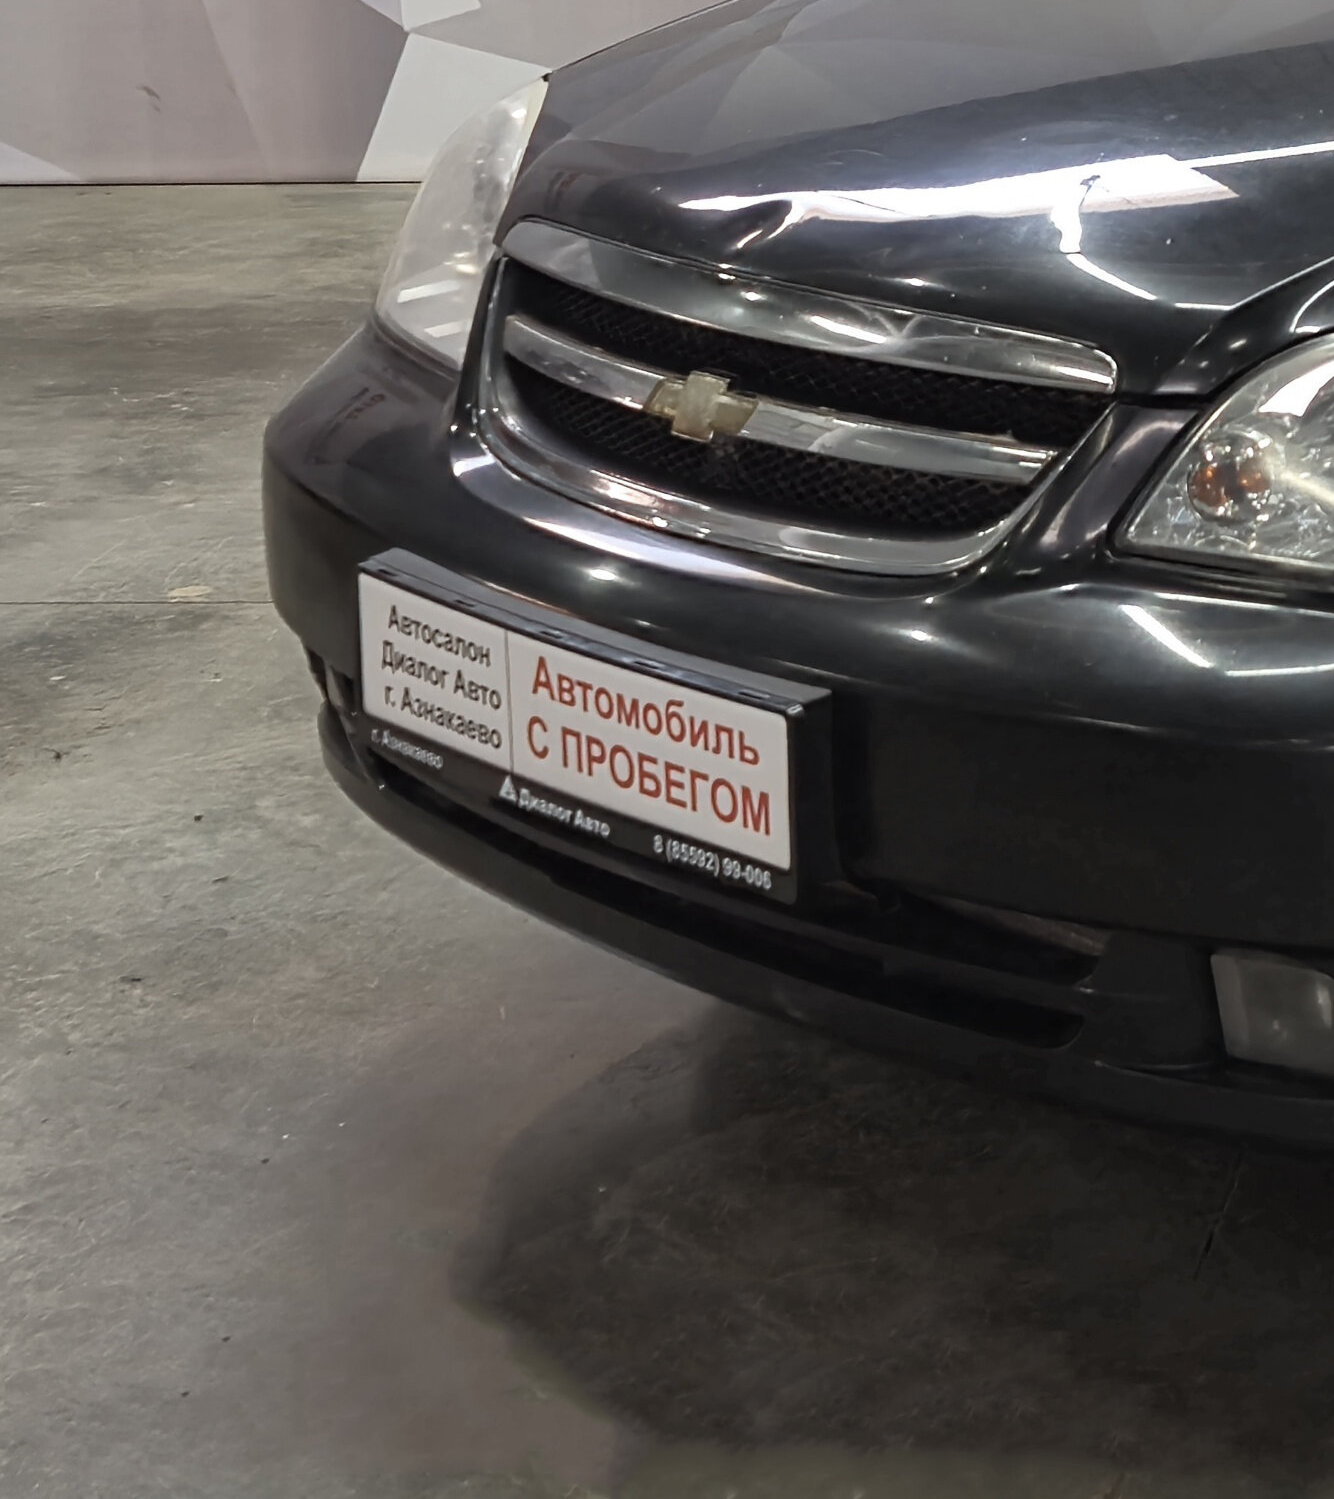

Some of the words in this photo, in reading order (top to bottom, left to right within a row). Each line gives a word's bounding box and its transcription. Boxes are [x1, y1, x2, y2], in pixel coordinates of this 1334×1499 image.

[388, 604, 491, 667] Автосалон
[381, 639, 450, 690] Диалог
[453, 669, 502, 710] Авто
[384, 685, 396, 708] г.
[400, 686, 502, 749] Азнакаево
[532, 655, 760, 766] Автомобиль
[527, 715, 549, 760] С
[560, 726, 771, 837] ПРОБЕГОМ
[517, 787, 573, 824] Диалог
[573, 808, 610, 838] Авто
[653, 834, 664, 853] 8
[665, 838, 720, 878] (85592)
